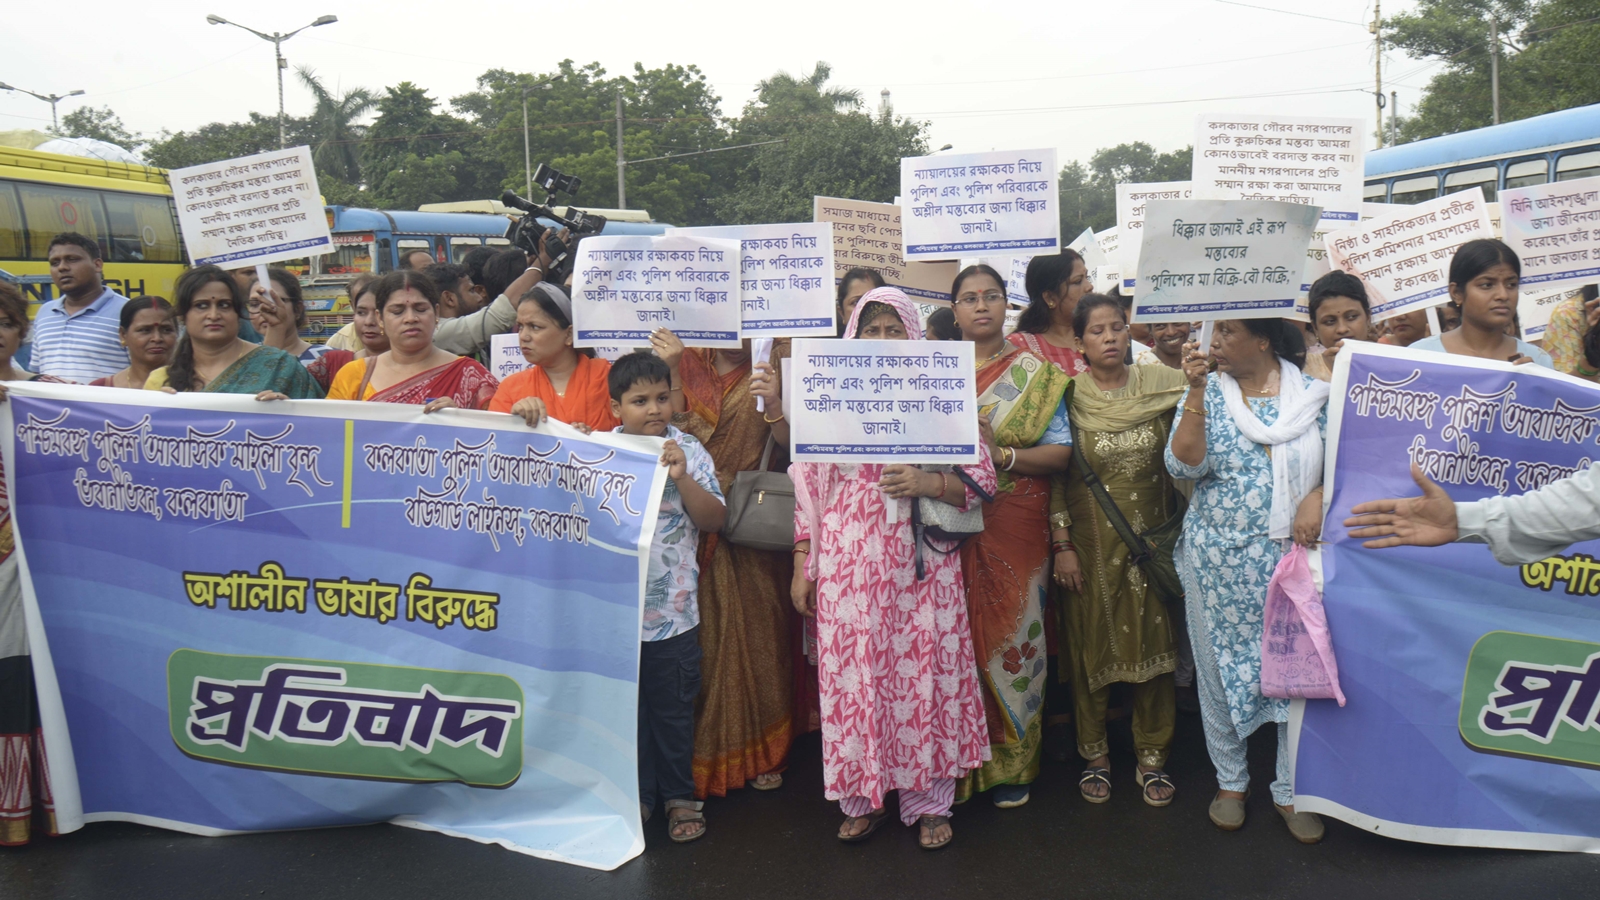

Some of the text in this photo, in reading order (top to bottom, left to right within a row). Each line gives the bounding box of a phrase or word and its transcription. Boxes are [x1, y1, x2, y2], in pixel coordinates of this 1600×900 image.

[1209, 121, 1352, 134] কলকাতার গৌরব নগরপালের
[1210, 134, 1350, 148] প্রতি কুরুচিকর মন্তব্য আমরা
[1204, 149, 1268, 159] কোনওভাবেই
[1273, 152, 1307, 162] বরদাস্ত
[1312, 153, 1335, 161] করব
[181, 155, 299, 185] কলকাতার গৌরব নগরপালের
[969, 163, 1014, 176] রক্ষাকবচ
[1018, 159, 1042, 173] নিয়ে
[1259, 167, 1314, 177] নগরপালের
[1318, 167, 1339, 178] প্রতি
[187, 169, 301, 199] প্রতি কুরুচিকর মন্তব্য আমরা
[910, 179, 1048, 202] পুলিশ এবং পুলিশ পরিবারকে
[1215, 180, 1342, 192] সম্মান রক্ষা করা আমাদের
[186, 195, 238, 212] কোনওভাবেই
[240, 190, 269, 202] বরদাস্ত
[273, 186, 293, 196] করব
[1130, 191, 1180, 200] কলকাতার
[234, 204, 279, 218] নগরপালের
[282, 198, 300, 211] প্রতি
[912, 198, 1046, 217] অশ্লীল মন্তব্যের জন্য ধিক্কার
[1510, 198, 1532, 213] যিনি
[823, 207, 853, 218] সমাজ
[856, 211, 890, 222] মাধ্যমে
[1531, 217, 1554, 229] জন্য
[201, 212, 306, 238] সম্মান রক্ষা করা আমাদের
[858, 223, 877, 235] ছবি
[961, 219, 997, 234] জানাই।
[1173, 218, 1286, 240] ধিক্কার জানাই এই রূপ
[1335, 236, 1358, 253] নিষ্ঠা
[1362, 233, 1370, 243] ও
[1372, 211, 1436, 239] সাহসিকতার
[1440, 200, 1475, 220] প্রতীক
[227, 235, 254, 248] নৈতিক
[741, 234, 816, 250] রক্ষাকবচ নিয়ে
[847, 236, 888, 249] পুলিশকে
[1341, 252, 1370, 272] পুলিশ
[1374, 235, 1424, 258] কমিশনার
[1427, 219, 1480, 242] মহাশয়ের
[648, 250, 695, 262] রক্ষাকবচ
[699, 247, 723, 262] নিয়ে
[851, 249, 885, 263] বিরুদ্ধে
[1205, 246, 1248, 261] মন্তব্যের
[1523, 255, 1546, 267] মানে
[1549, 250, 1588, 264] জনতার
[769, 255, 823, 270] পরিবারকে
[582, 267, 730, 285] পুলিশ এবং পুলিশ পরিবারকে
[1198, 273, 1210, 286] মা
[1361, 265, 1392, 282] সম্মান
[761, 279, 785, 291] জন্য
[789, 274, 822, 292] ধিক্কার
[583, 285, 728, 305] অশ্লীল মন্তব্যের জন্য ধিক্কার
[1536, 293, 1561, 306] করার
[637, 308, 675, 322] জানাই।
[876, 355, 929, 368] রক্ষাকবচ
[933, 352, 958, 368] নিয়ে
[499, 361, 522, 377] পুলিশ
[803, 373, 965, 393] পুলিশ এবং পুলিশ পরিবারকে
[804, 395, 963, 415] অশ্লীল মন্তব্যের জন্য ধিক্কার
[1349, 369, 1440, 428] পশ্চিমবঙ্গ
[1442, 382, 1516, 442] পুলিশ
[863, 419, 906, 435] জানাই।
[17, 409, 333, 496] পশ্চিমবঙ্গ পুলিশ আবাসিক মহিলা বৃন্দ
[363, 433, 641, 526] কলকাতা পুলিশ আবাসিক মহিলা বৃন্দ
[165, 480, 248, 521] কলকাতা
[530, 505, 589, 545] কলকাতা
[183, 561, 500, 631] অশালীন ভাষার বিরুদ্ধে
[187, 663, 521, 758] প্রতিবাদ
